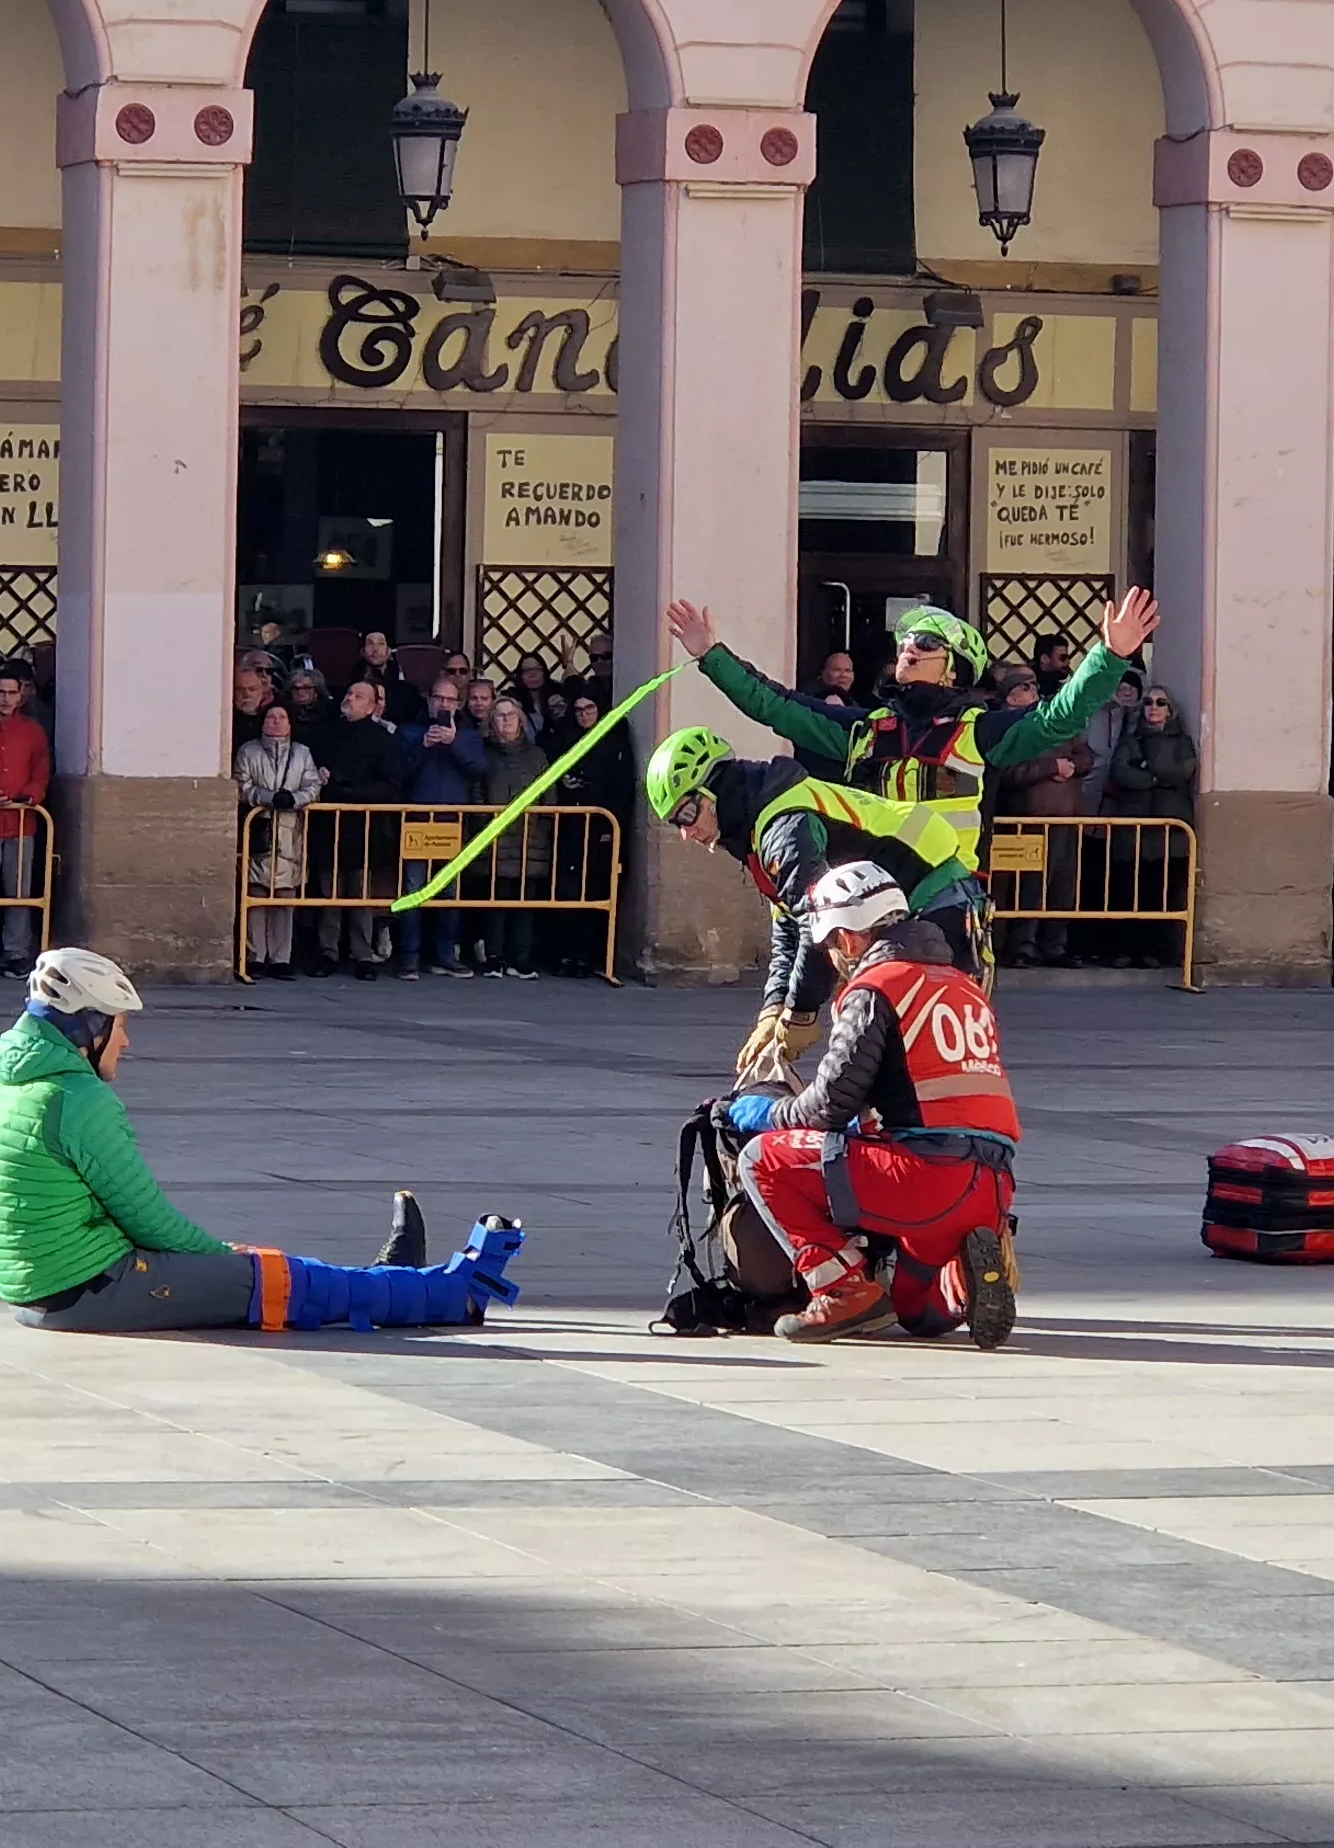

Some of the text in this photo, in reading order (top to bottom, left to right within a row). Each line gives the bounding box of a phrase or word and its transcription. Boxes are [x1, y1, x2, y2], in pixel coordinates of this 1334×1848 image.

[496, 449, 526, 469] TE
[995, 460, 1017, 476] ME
[1021, 457, 1050, 476] PIDIÓ
[1071, 456, 1104, 476] CAFÉ
[501, 481, 611, 502] RECUERDO
[996, 482, 1006, 498] Y
[1013, 484, 1026, 498] LE
[505, 505, 601, 528] AMANDO
